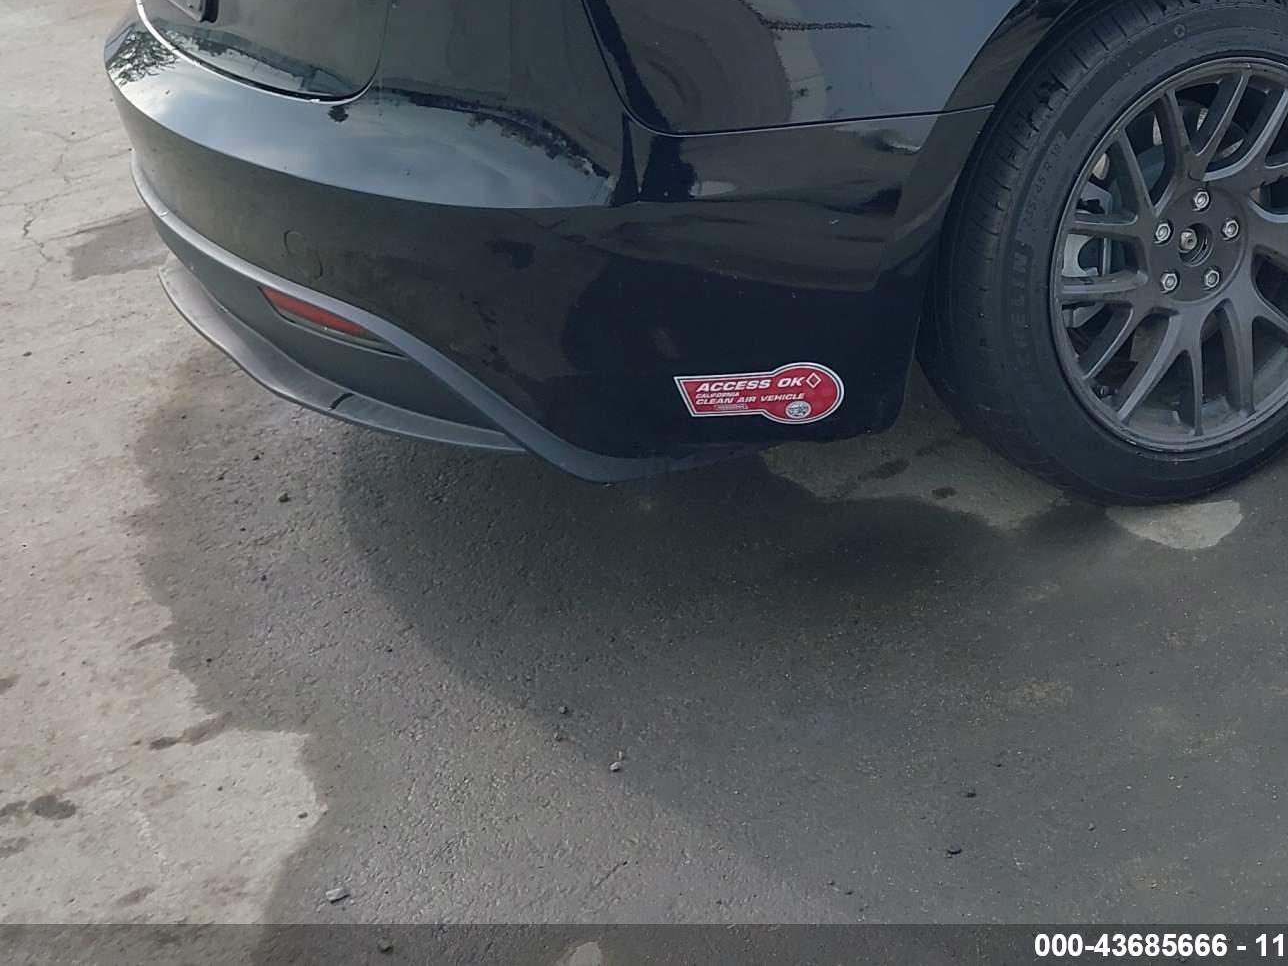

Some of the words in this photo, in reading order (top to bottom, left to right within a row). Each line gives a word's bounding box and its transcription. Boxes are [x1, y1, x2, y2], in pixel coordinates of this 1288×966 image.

[696, 380, 771, 392] ACCESS
[778, 376, 806, 388] OK
[696, 397, 734, 405] CLEAN
[737, 395, 757, 403] AIR
[760, 393, 805, 402] VEHICLE
